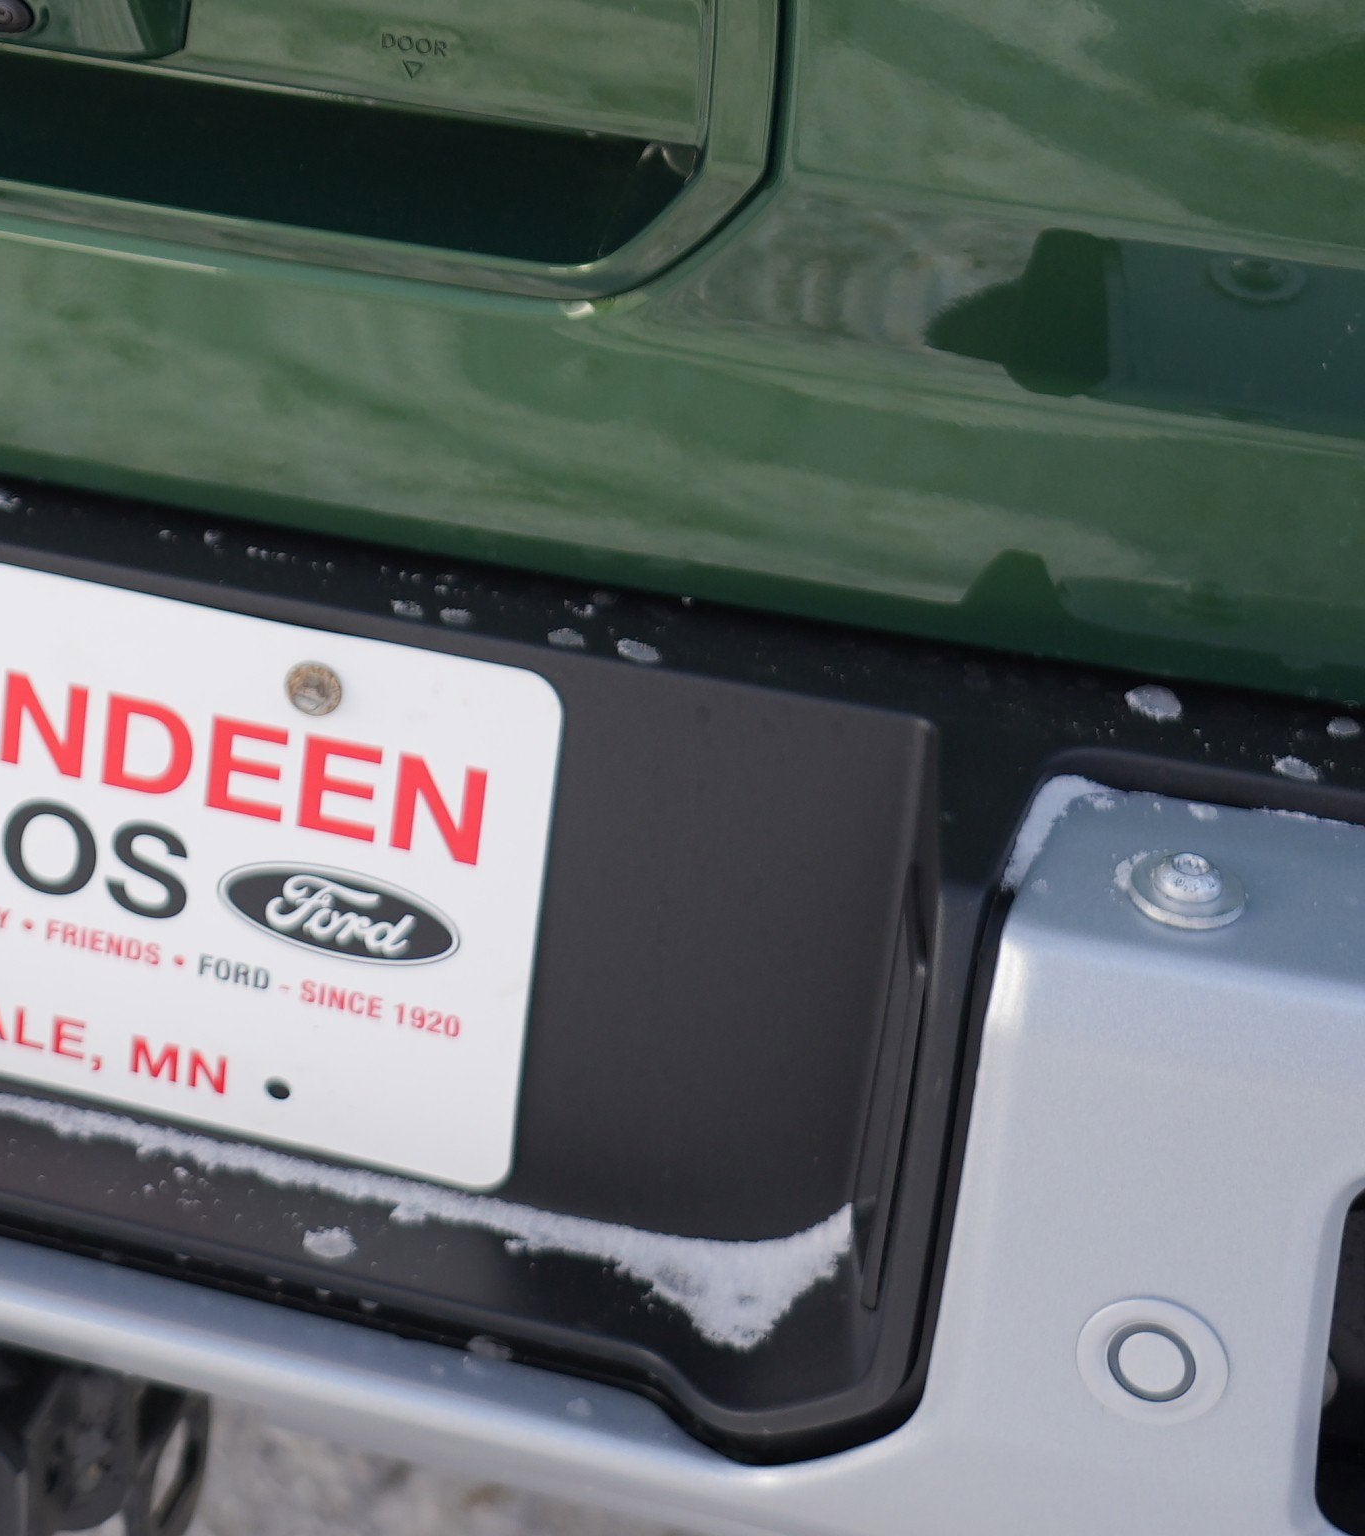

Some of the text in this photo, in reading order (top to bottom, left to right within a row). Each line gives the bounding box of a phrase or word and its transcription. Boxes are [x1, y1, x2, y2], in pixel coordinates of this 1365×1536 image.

[381, 32, 447, 57] DOOR
[265, 873, 417, 958] Ford
[45, 917, 162, 967] FRIENDS
[197, 952, 270, 991] FORD
[300, 978, 383, 1020] SINCE
[394, 1002, 462, 1039] 1920
[129, 1034, 230, 1096] MN
